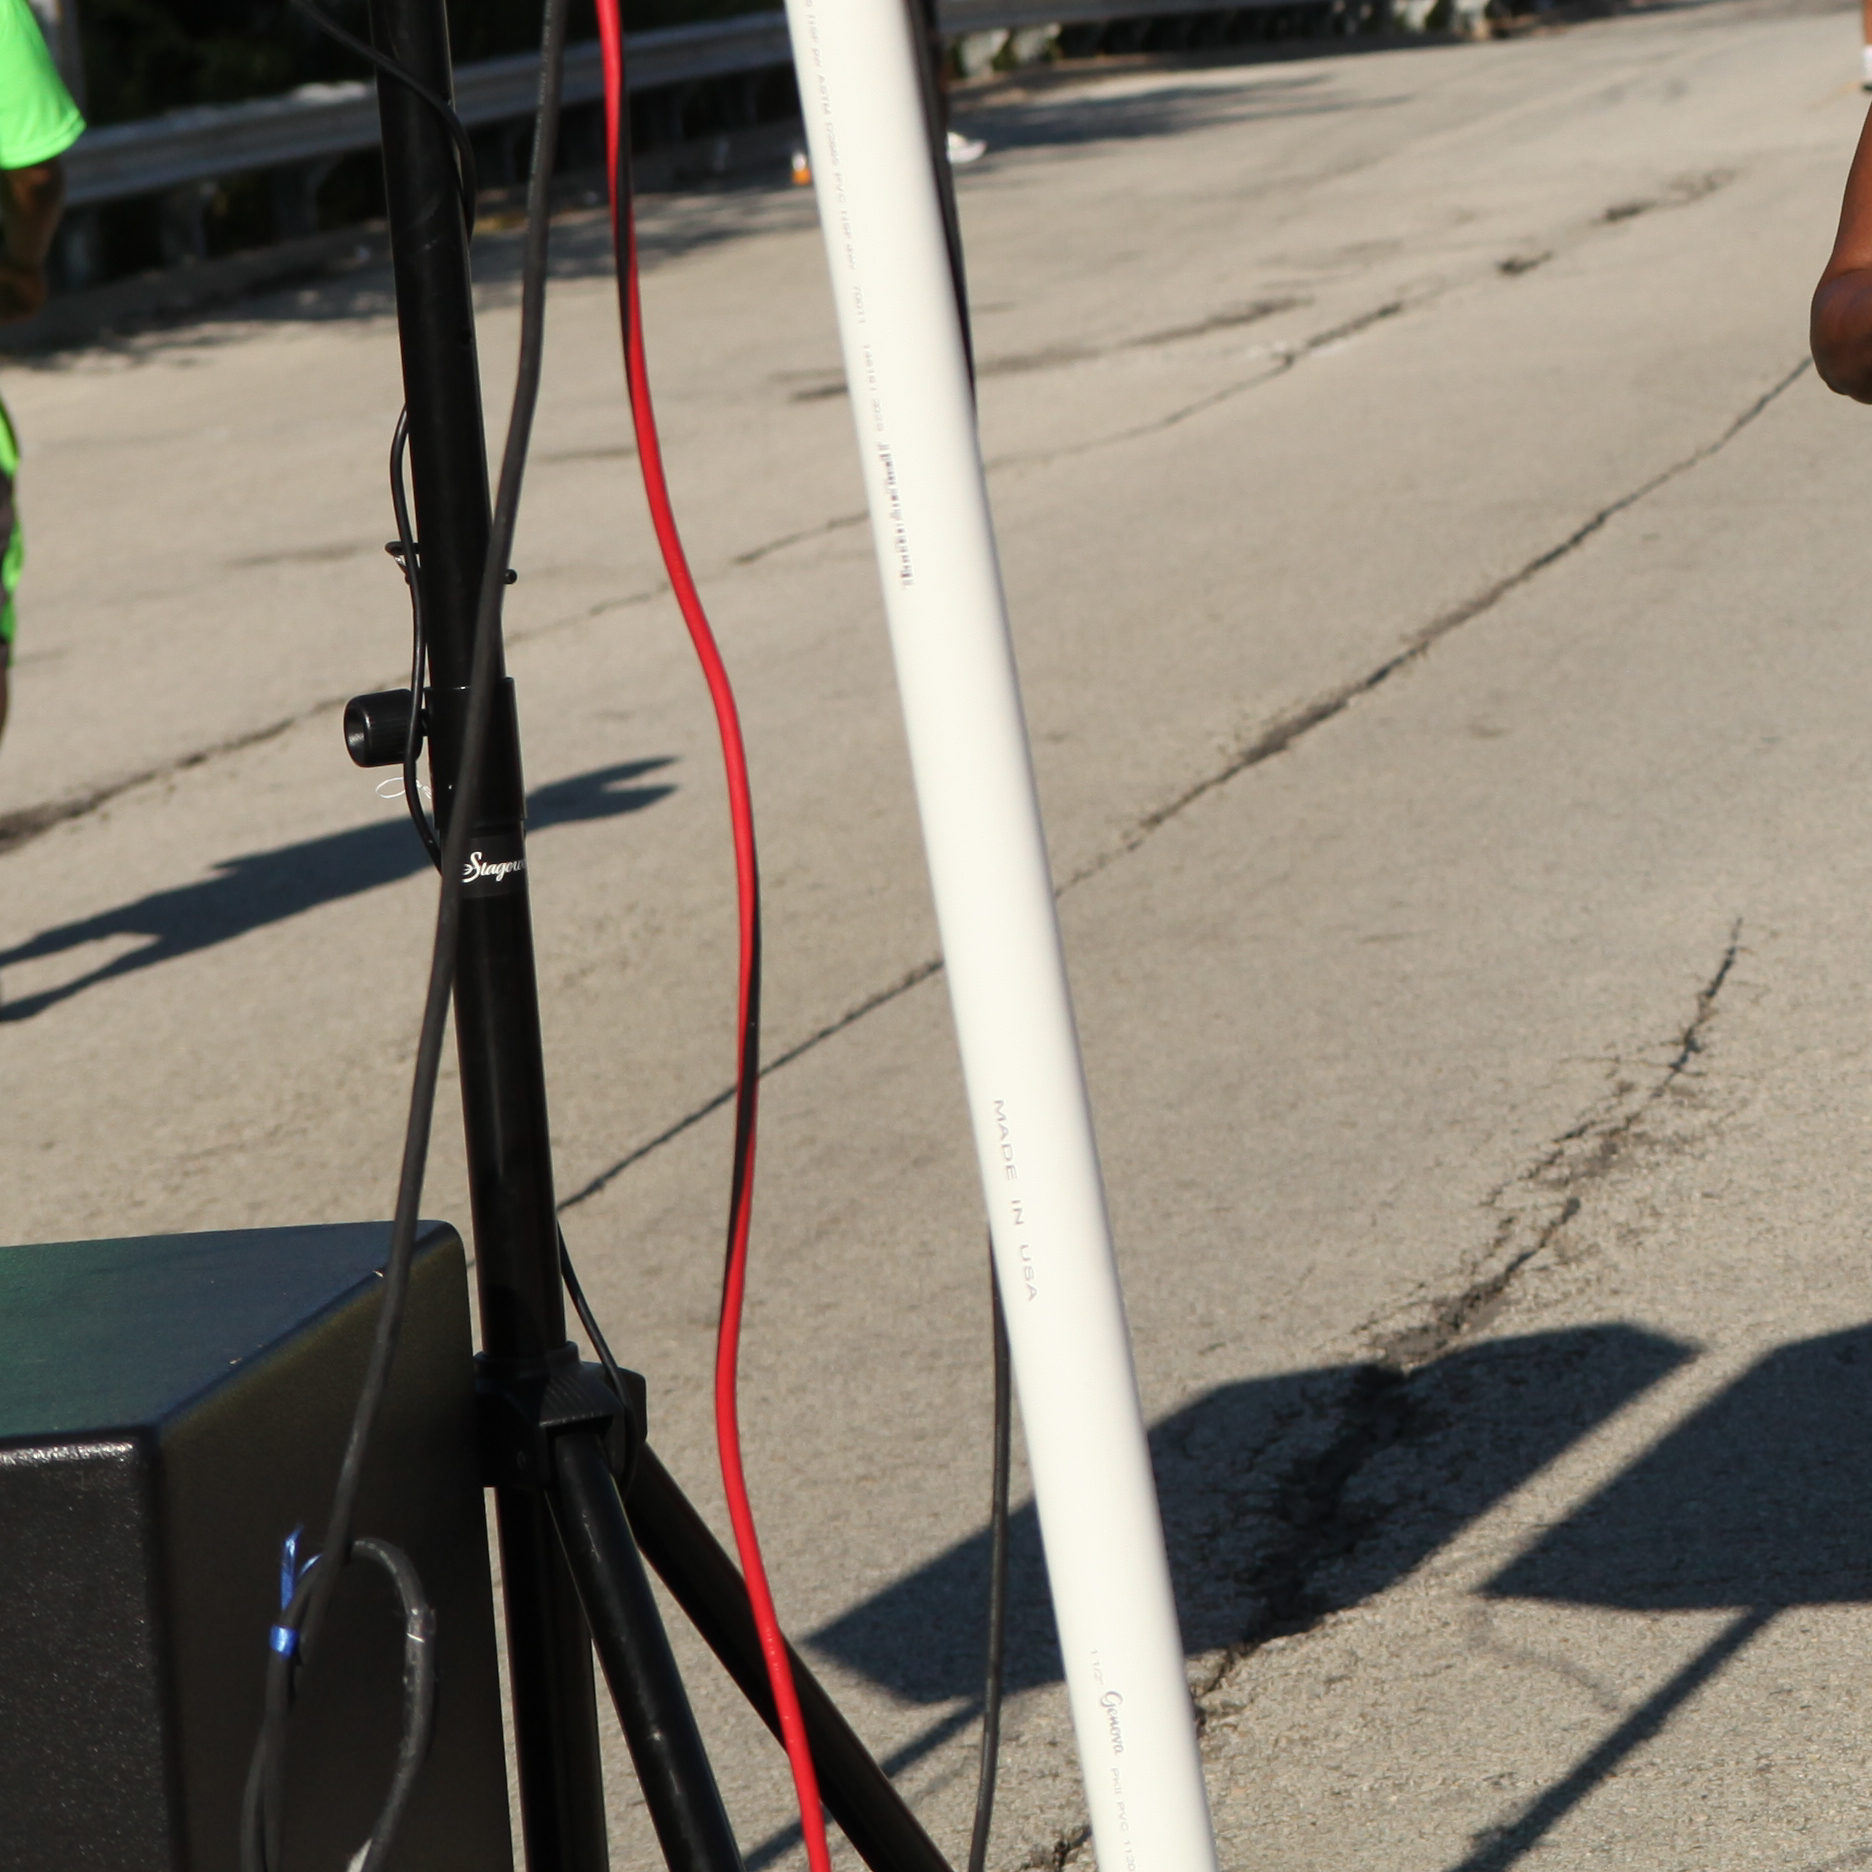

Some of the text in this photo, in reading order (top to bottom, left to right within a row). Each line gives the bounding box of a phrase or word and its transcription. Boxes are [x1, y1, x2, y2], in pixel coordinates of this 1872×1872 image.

[816, 73, 831, 114] ASTM
[992, 1099, 1039, 1301] MADE IN USA
[1099, 1690, 1129, 1755] Genova
[1115, 1801, 1129, 1831] PVC
[1121, 1840, 1136, 1871] 1120
